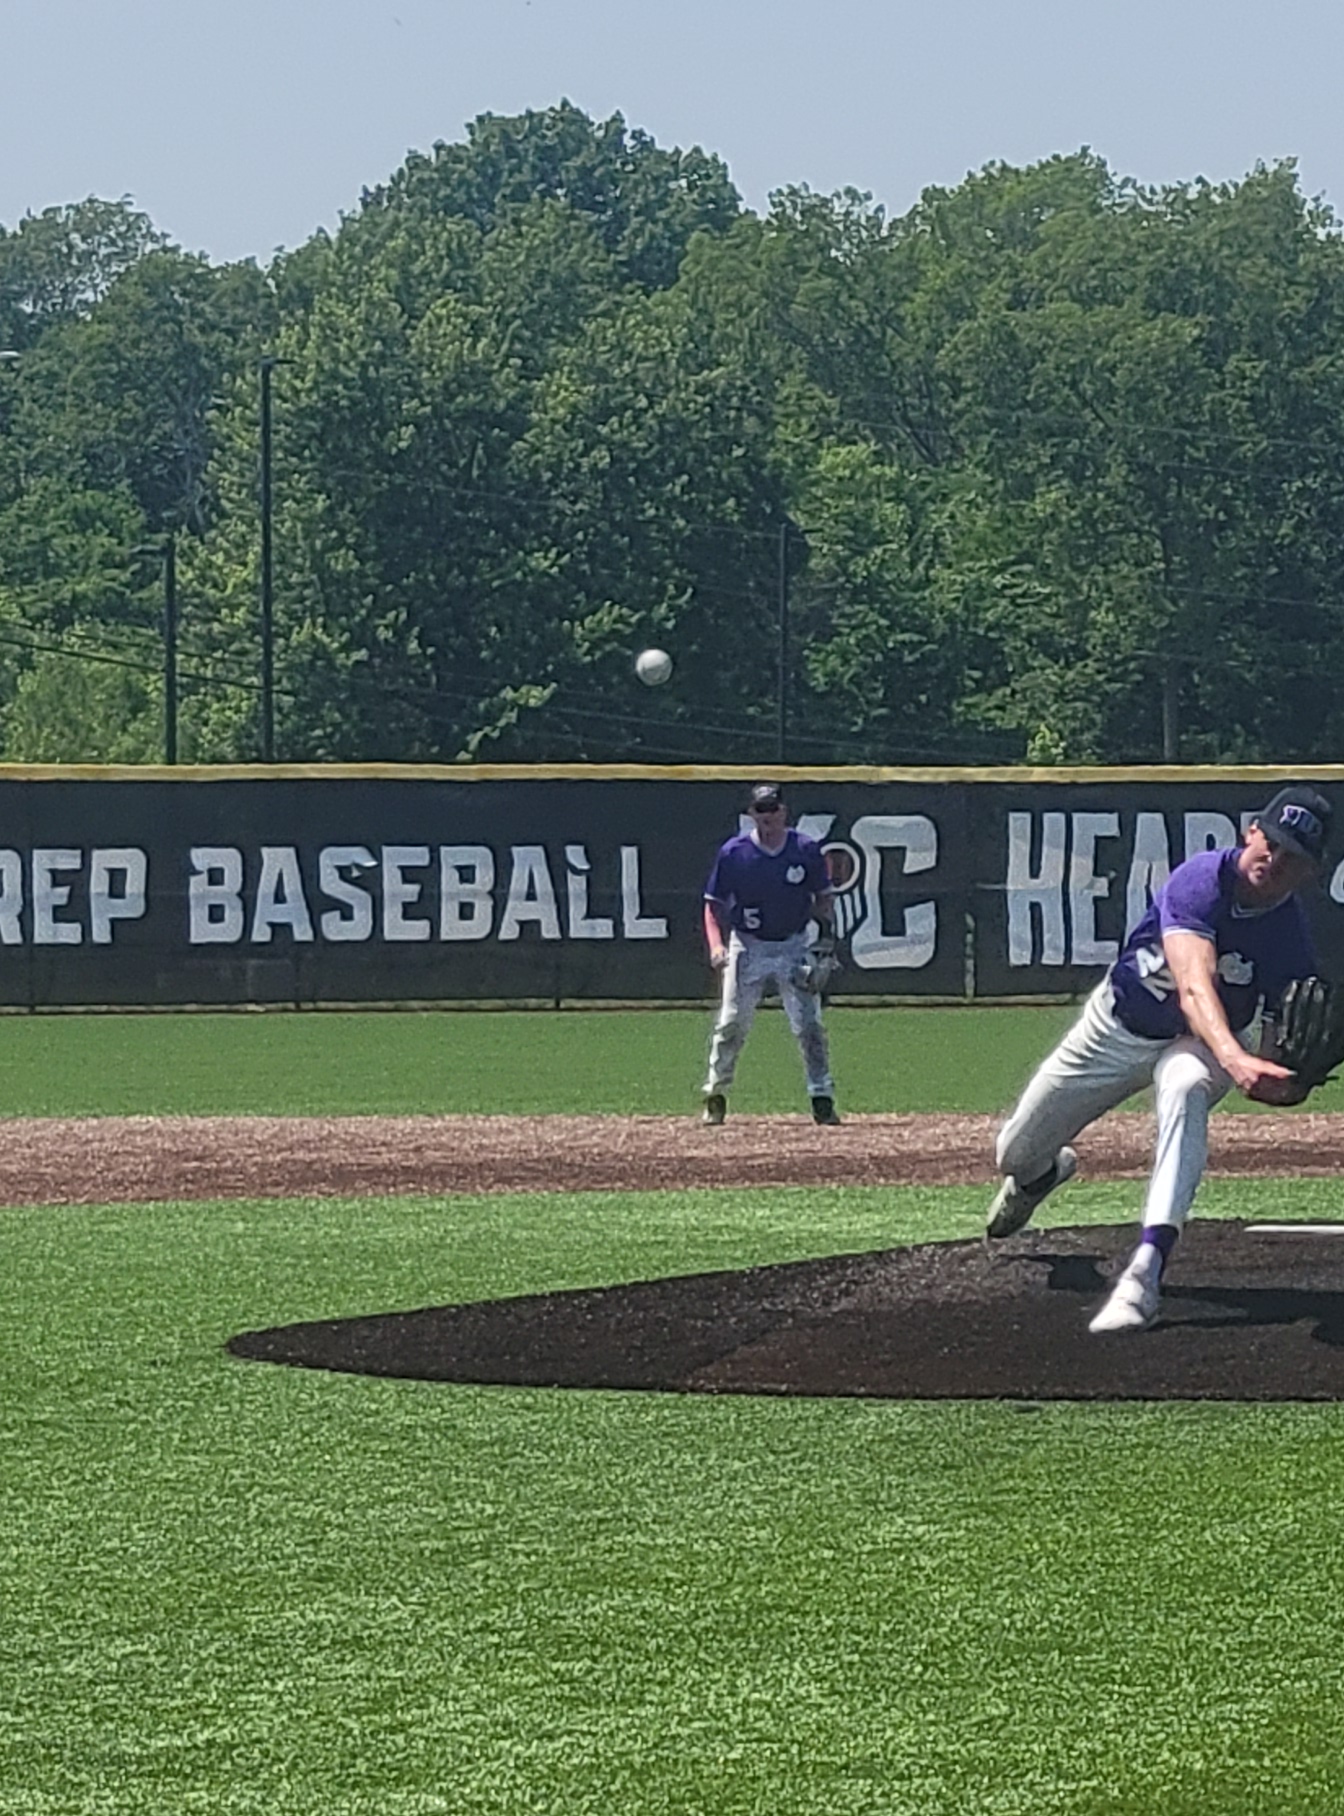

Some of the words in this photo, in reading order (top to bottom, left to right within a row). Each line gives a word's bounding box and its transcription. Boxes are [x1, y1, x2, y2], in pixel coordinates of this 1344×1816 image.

[189, 845, 668, 944] BASEBALL
[739, 813, 938, 969] C
[1007, 811, 1260, 966] HEA
[743, 907, 762, 930] 5
